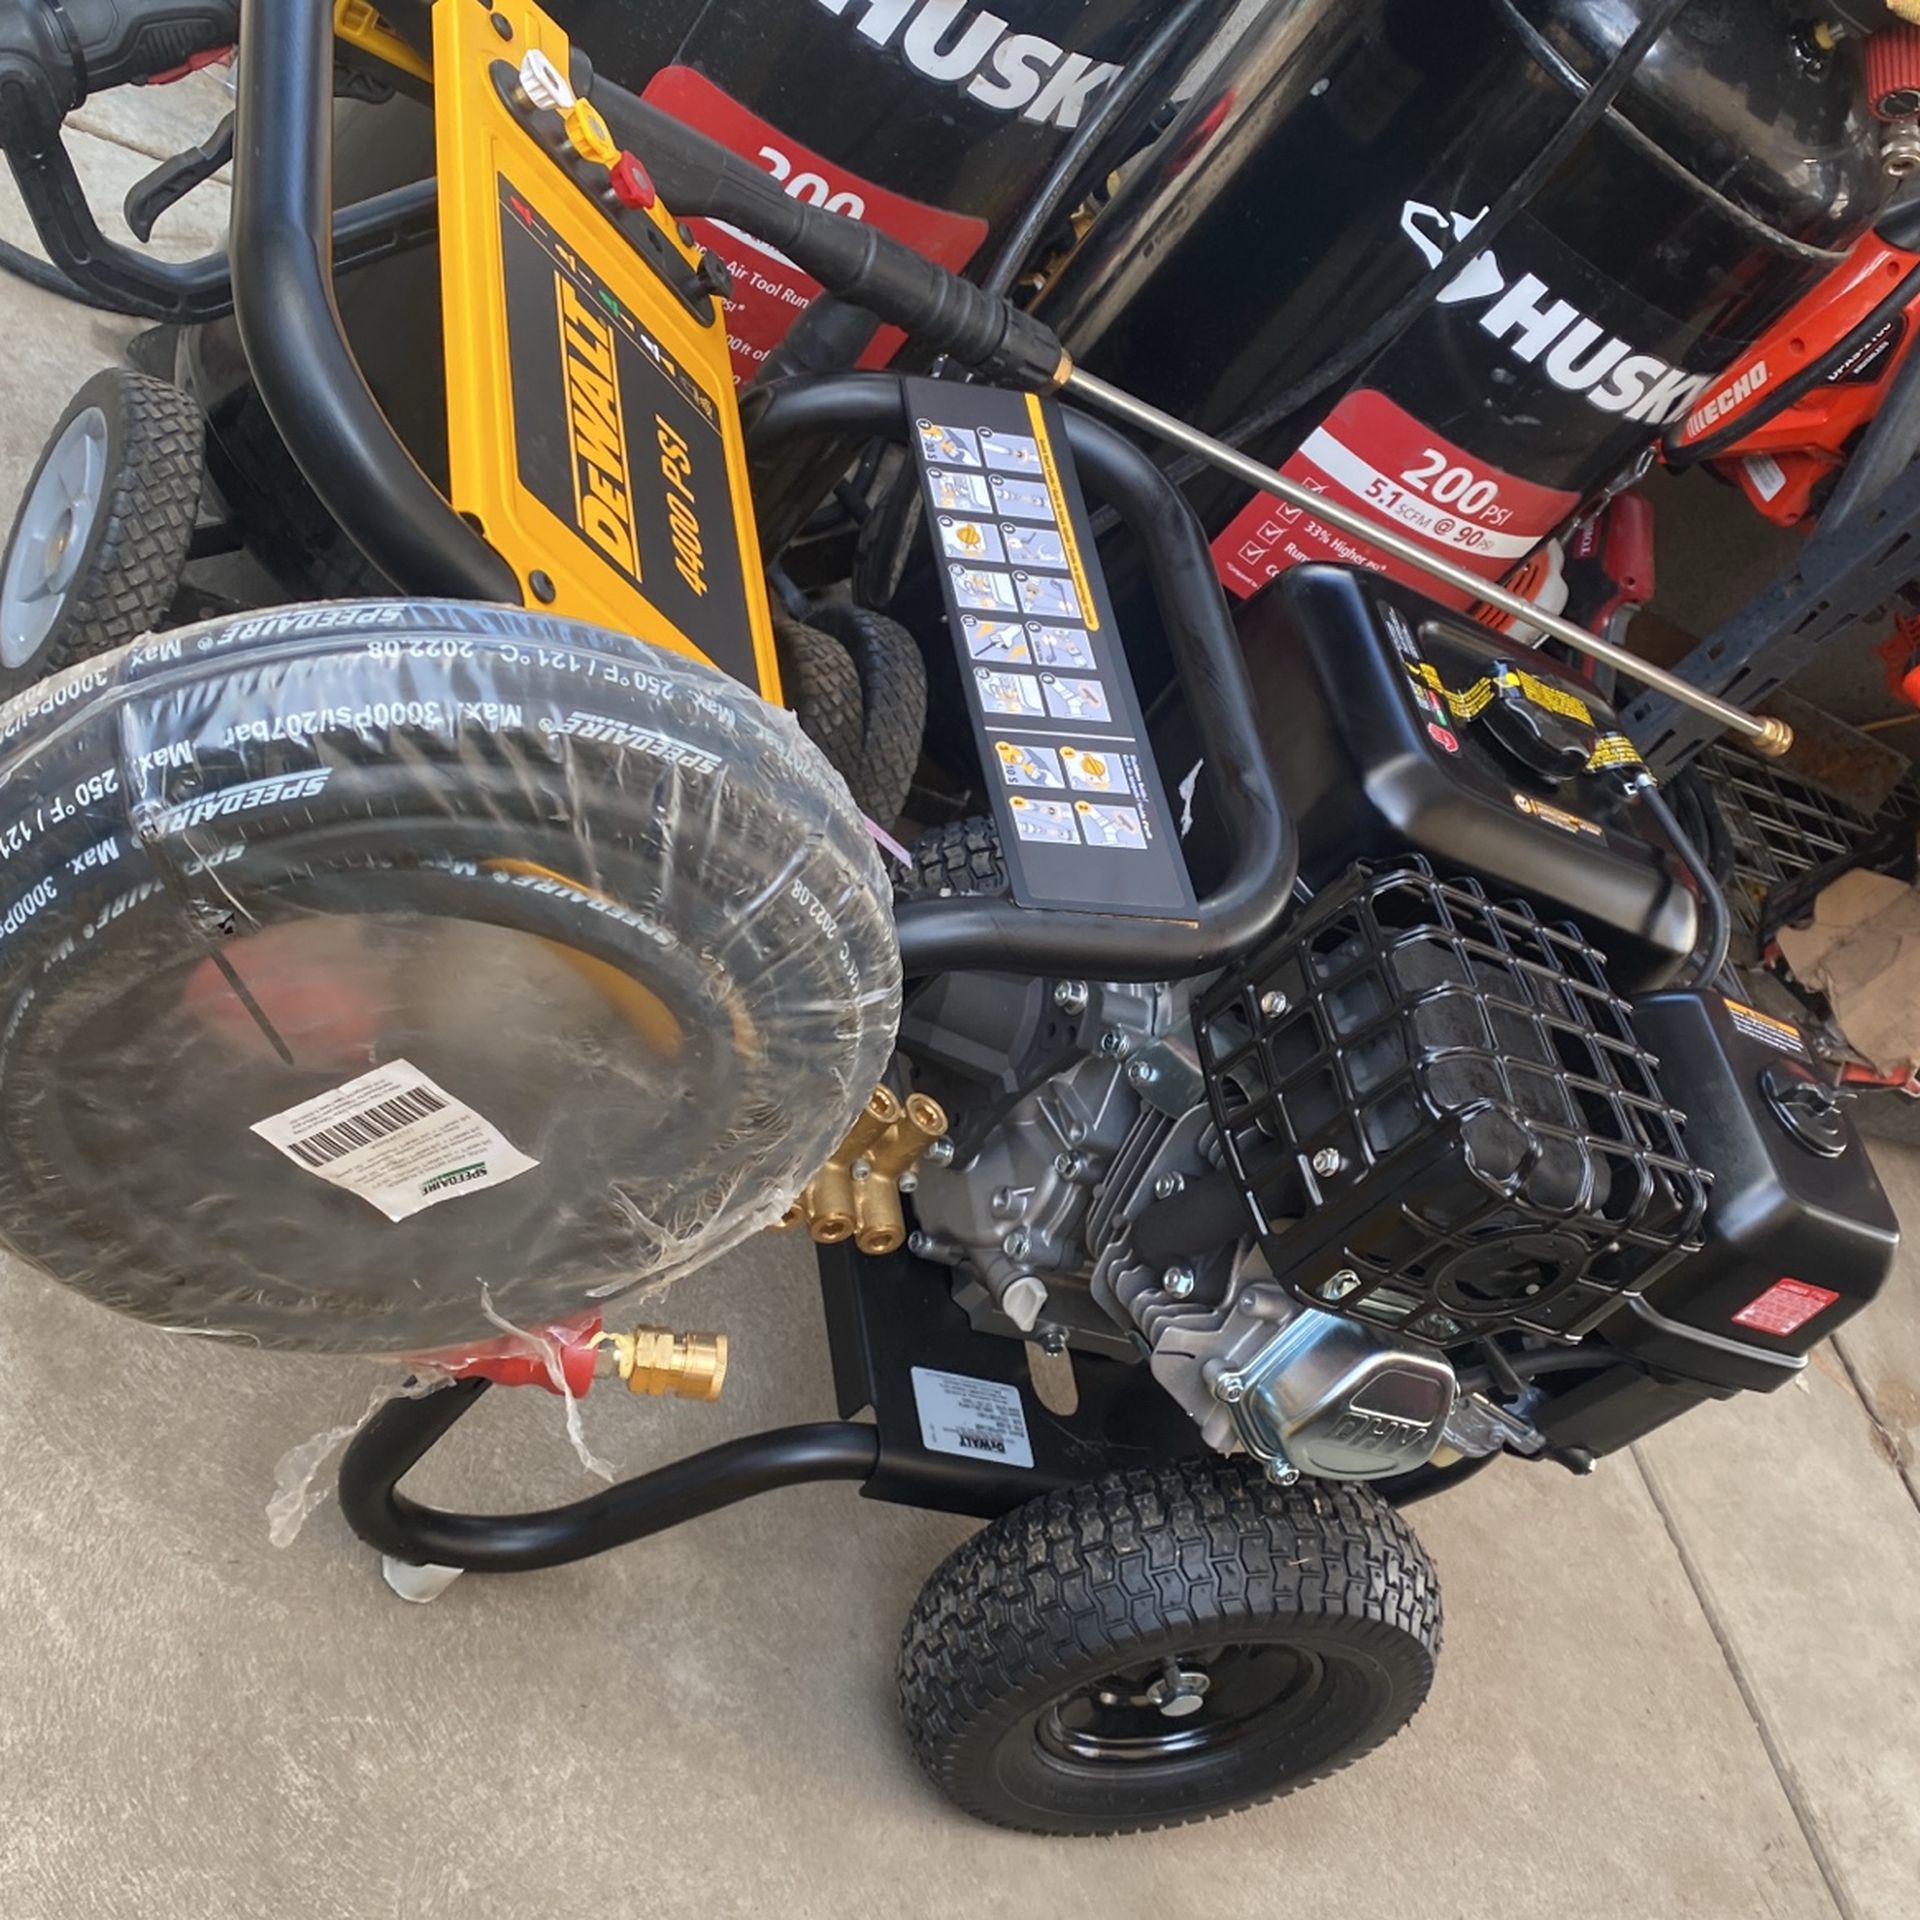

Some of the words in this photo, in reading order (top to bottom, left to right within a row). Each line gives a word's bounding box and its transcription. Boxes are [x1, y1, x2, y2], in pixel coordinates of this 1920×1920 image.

[814, 0, 1127, 129] HUSK
[726, 260, 749, 280] Air
[749, 271, 784, 297] Tool
[780, 285, 811, 309] Run
[1701, 360, 1768, 427] ECHO
[655, 413, 694, 491] PSI
[667, 492, 709, 597] 4400
[1304, 520, 1331, 544] 33%
[1330, 537, 1367, 565] Higher
